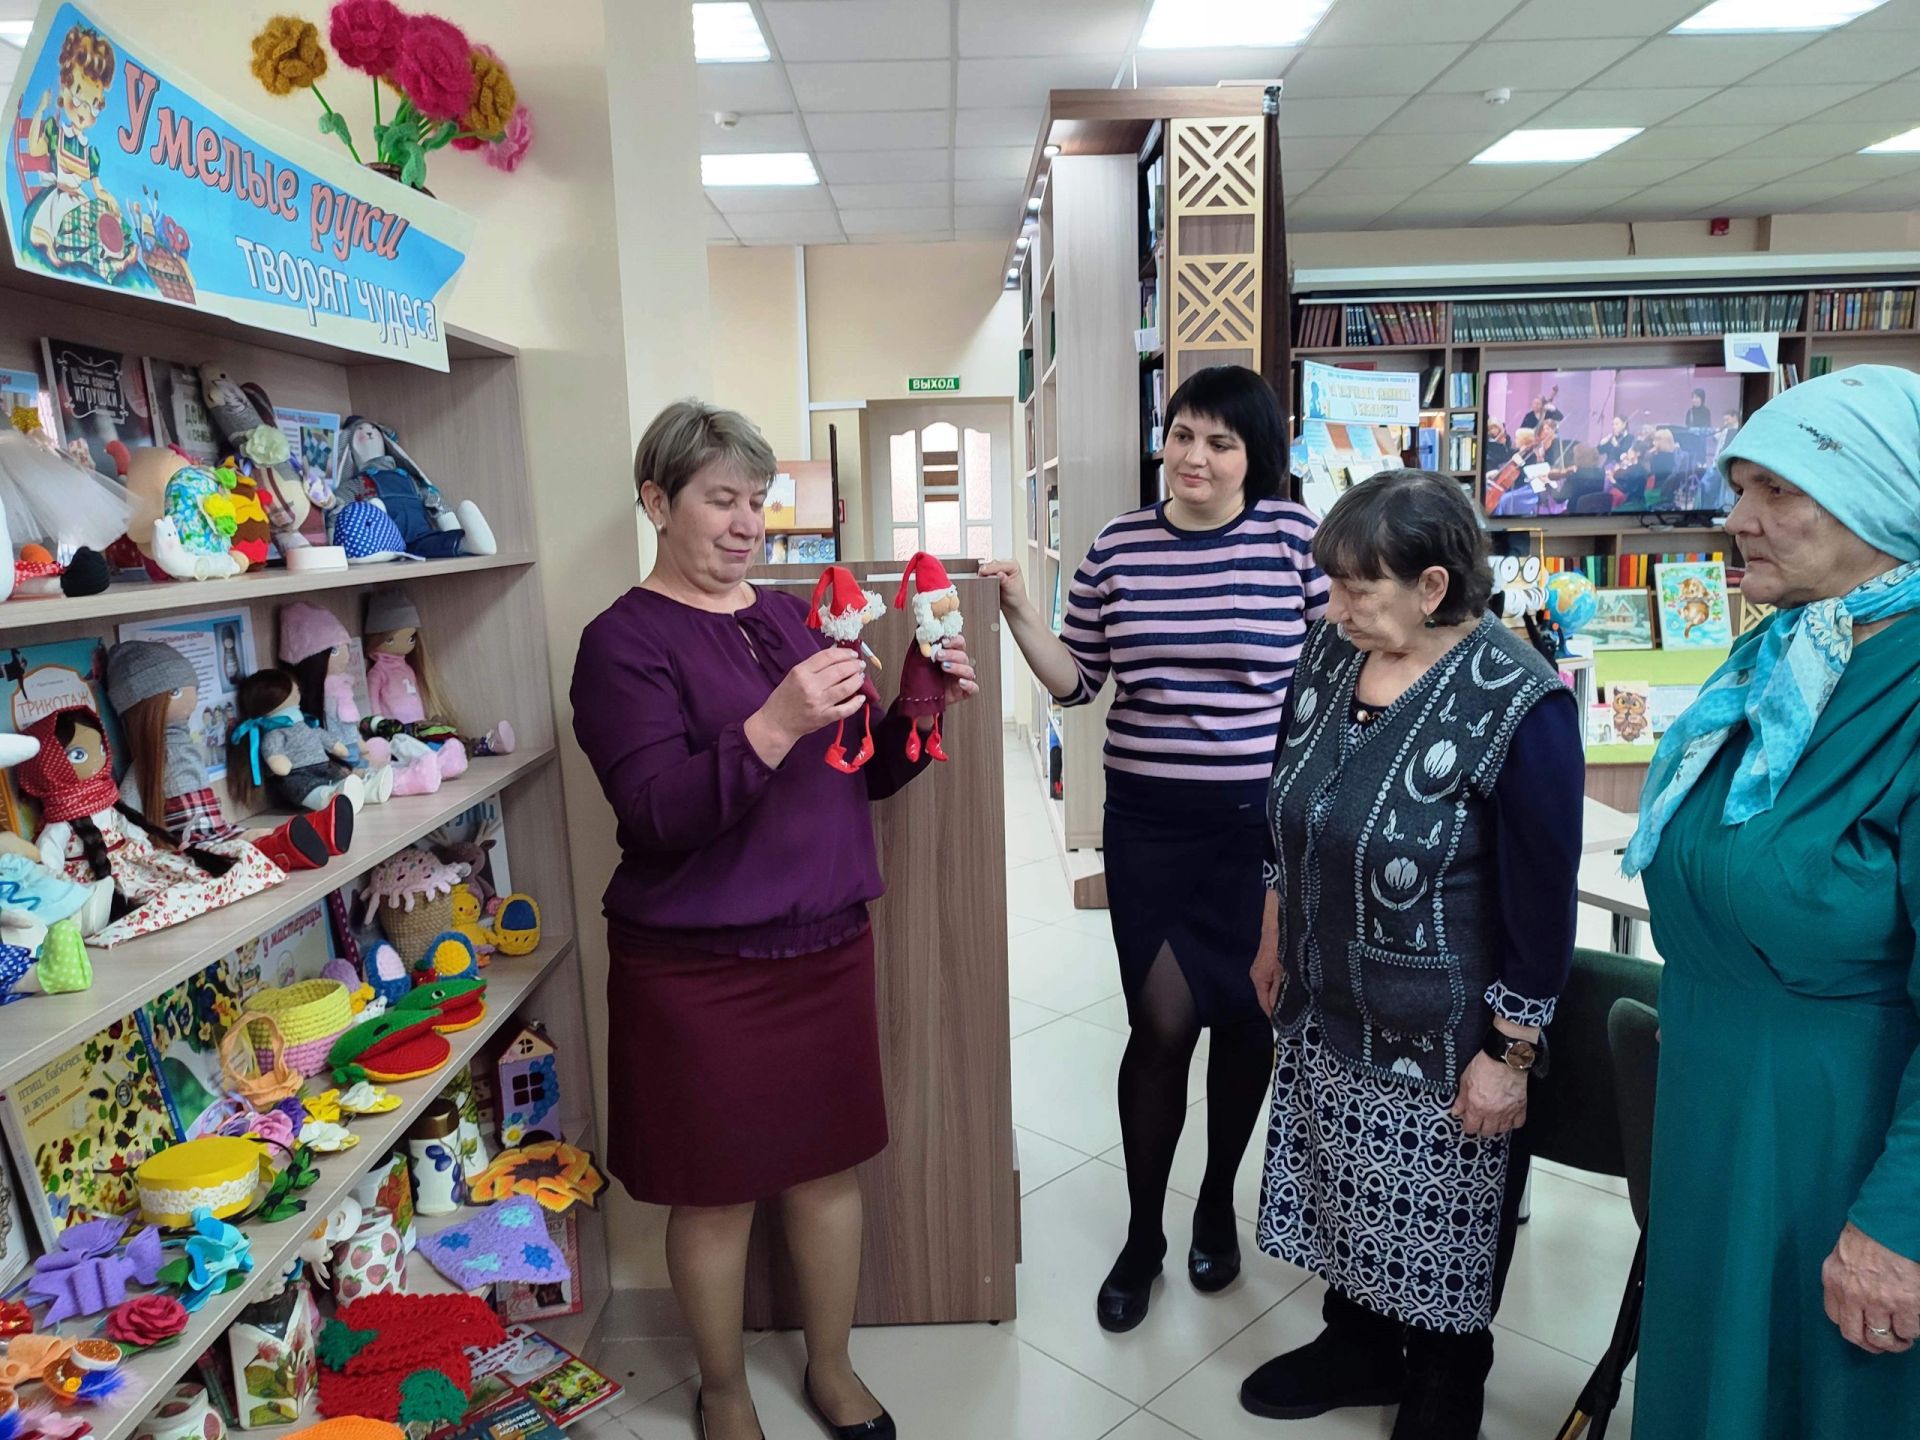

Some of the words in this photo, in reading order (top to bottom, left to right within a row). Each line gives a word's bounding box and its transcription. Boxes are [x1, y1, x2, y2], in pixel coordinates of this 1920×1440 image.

[118, 60, 299, 222] Умелые
[310, 182, 410, 262] руки
[354, 278, 438, 348] чудеса
[912, 378, 955, 390] ВЫХОД
[17, 690, 91, 719] ТРИКОТАЖ
